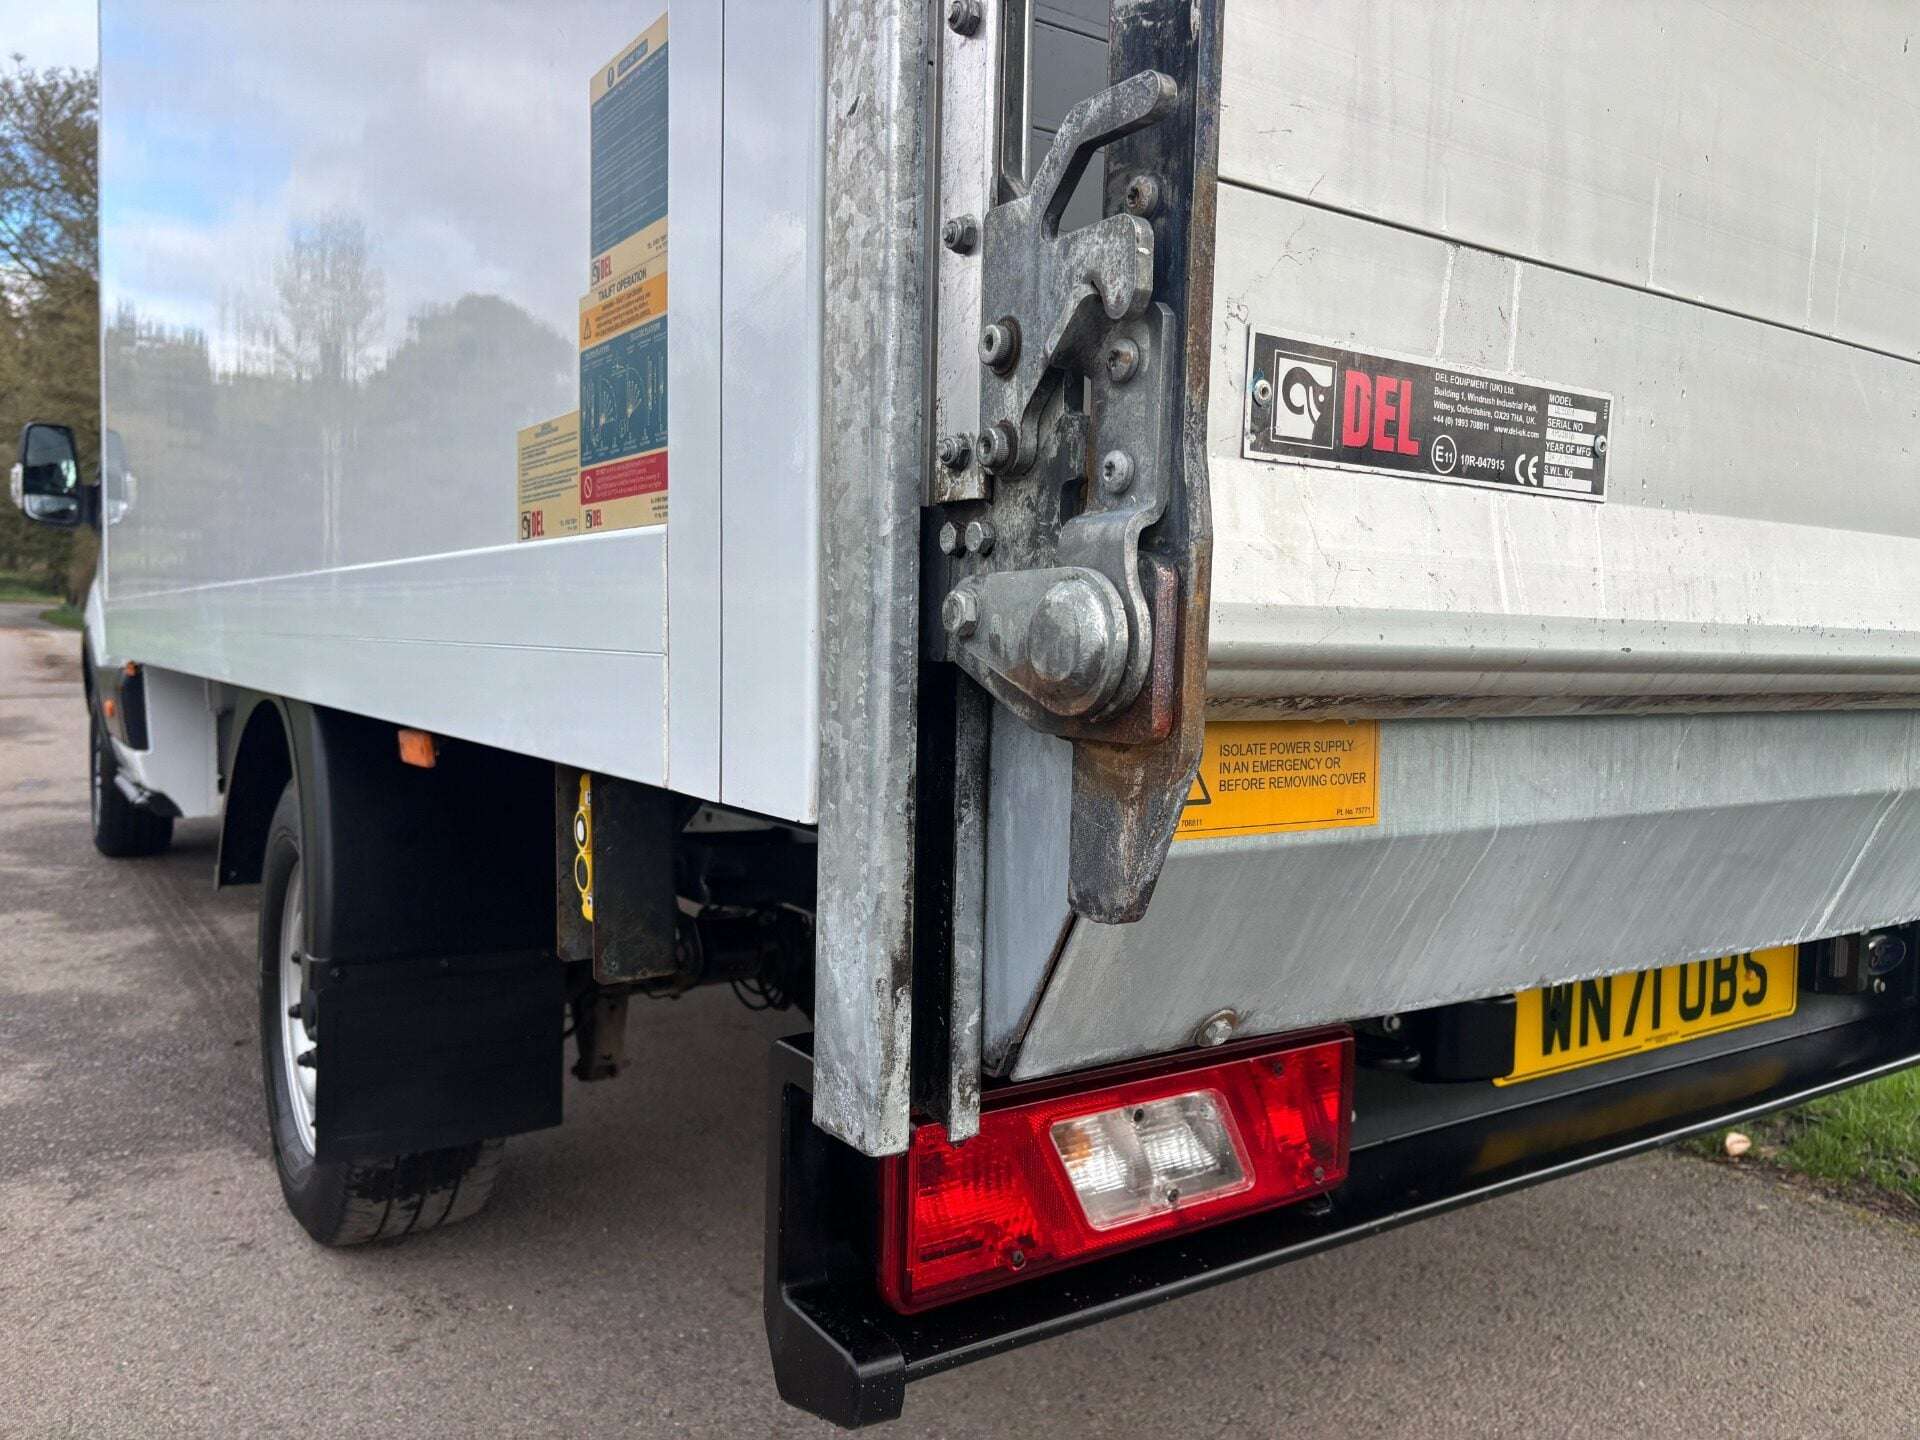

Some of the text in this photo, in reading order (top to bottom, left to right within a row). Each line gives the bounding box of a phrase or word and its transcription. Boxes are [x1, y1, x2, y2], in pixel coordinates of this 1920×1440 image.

[600, 255, 613, 280] DEL
[616, 267, 647, 292] OPERATION
[1435, 372, 1515, 395] DEL EQUIPMENT (UK) Ltd.
[1434, 386, 1460, 401] Building
[1467, 392, 1496, 405] Windrush
[1496, 397, 1523, 410] Industrial
[1549, 393, 1573, 407] MODEL
[1342, 369, 1421, 456] DEL
[1456, 403, 1493, 419] Oxfordshire,
[1493, 410, 1510, 421] OX29
[1432, 414, 1444, 424] +44
[1455, 417, 1469, 428] 1993
[1493, 425, 1540, 439] www.del-uk.com
[1547, 417, 1584, 432] SERIAL NO
[1545, 441, 1591, 457] YEAR OF MFG
[1460, 454, 1505, 471] 10R-047915
[1564, 467, 1574, 479] Kg
[531, 510, 544, 537] DEL
[592, 509, 602, 527] DEL
[1219, 739, 1354, 758] ISOLATE POWER SUPPLY
[1219, 756, 1341, 774] IN AN EMERGENCY OR
[1219, 771, 1366, 792] BEFORE REMOVING COVER
